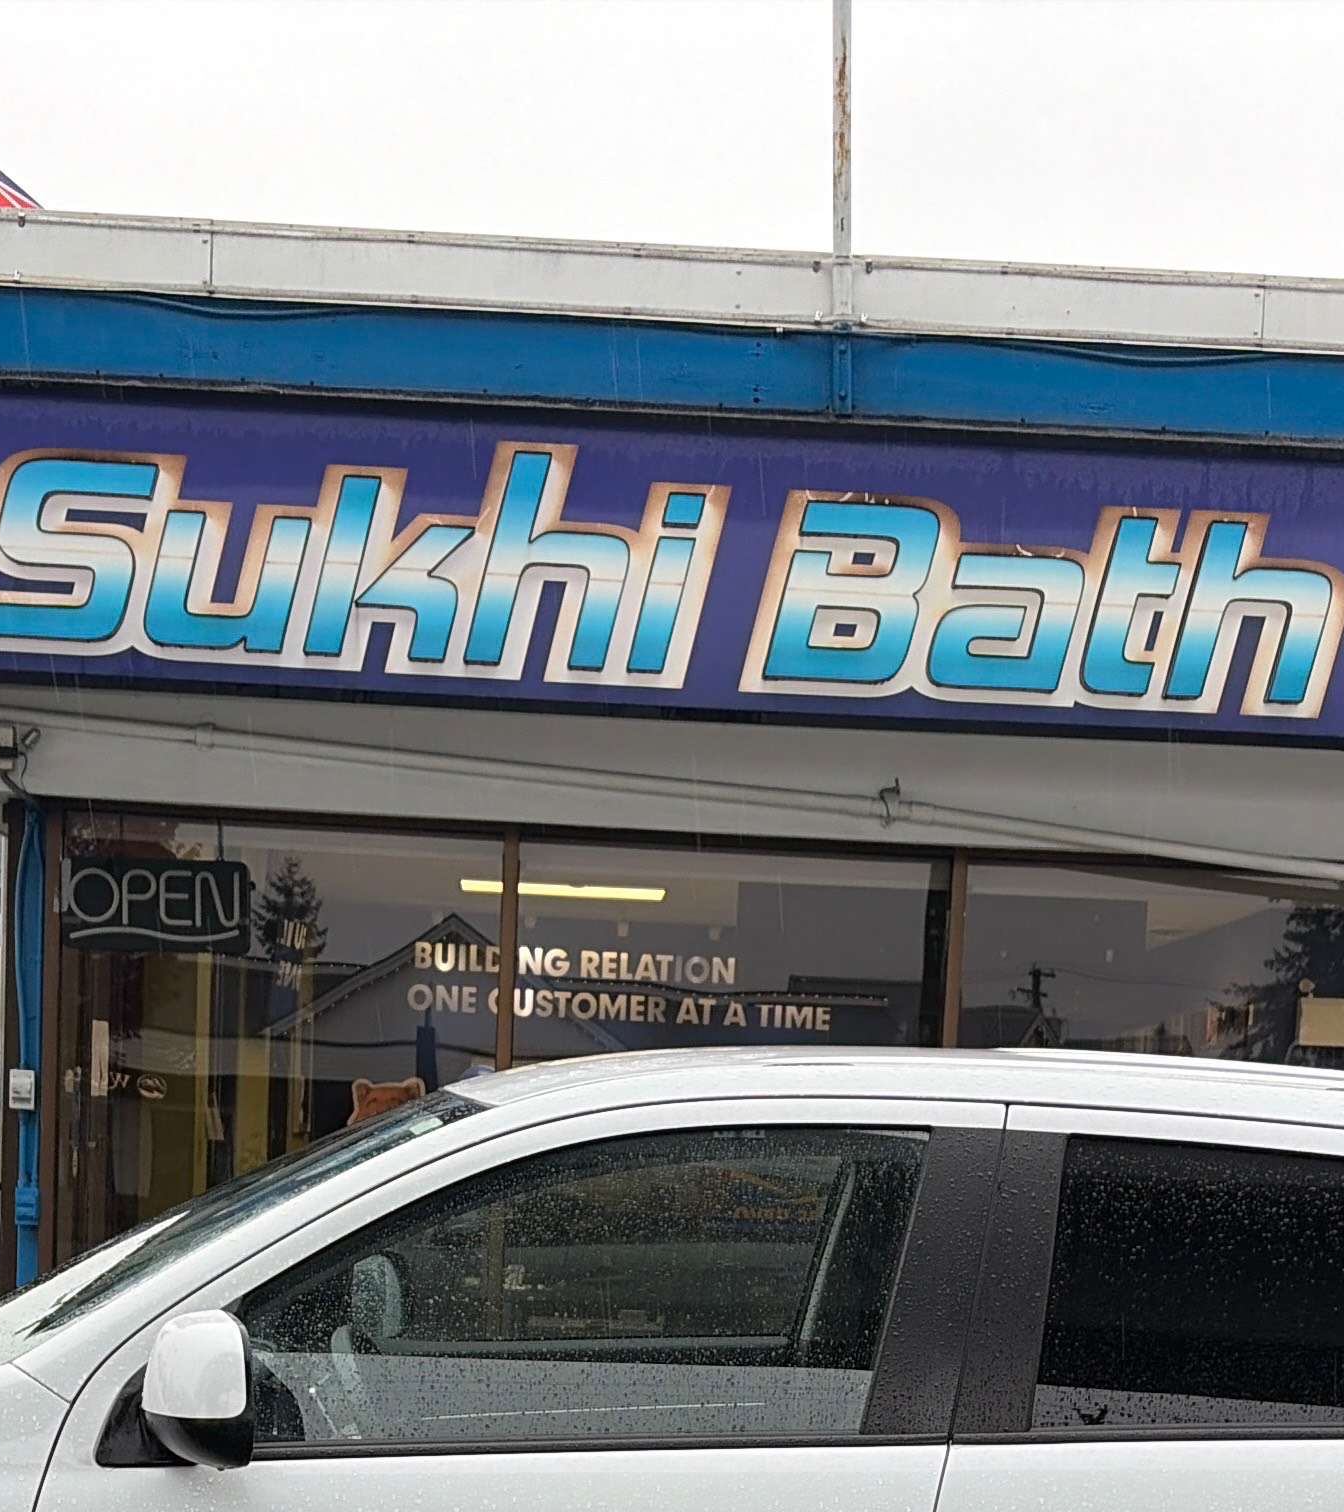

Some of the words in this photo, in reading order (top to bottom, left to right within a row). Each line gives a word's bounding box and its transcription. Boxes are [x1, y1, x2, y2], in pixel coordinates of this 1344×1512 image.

[748, 492, 1344, 712] Bath
[69, 866, 241, 928] OPEN
[413, 940, 571, 978] BUILDNG
[580, 949, 737, 985] RELATION
[406, 983, 477, 1014] ONE
[675, 997, 715, 1026] AT
[722, 1000, 747, 1028] A
[759, 1003, 833, 1032] TIME
